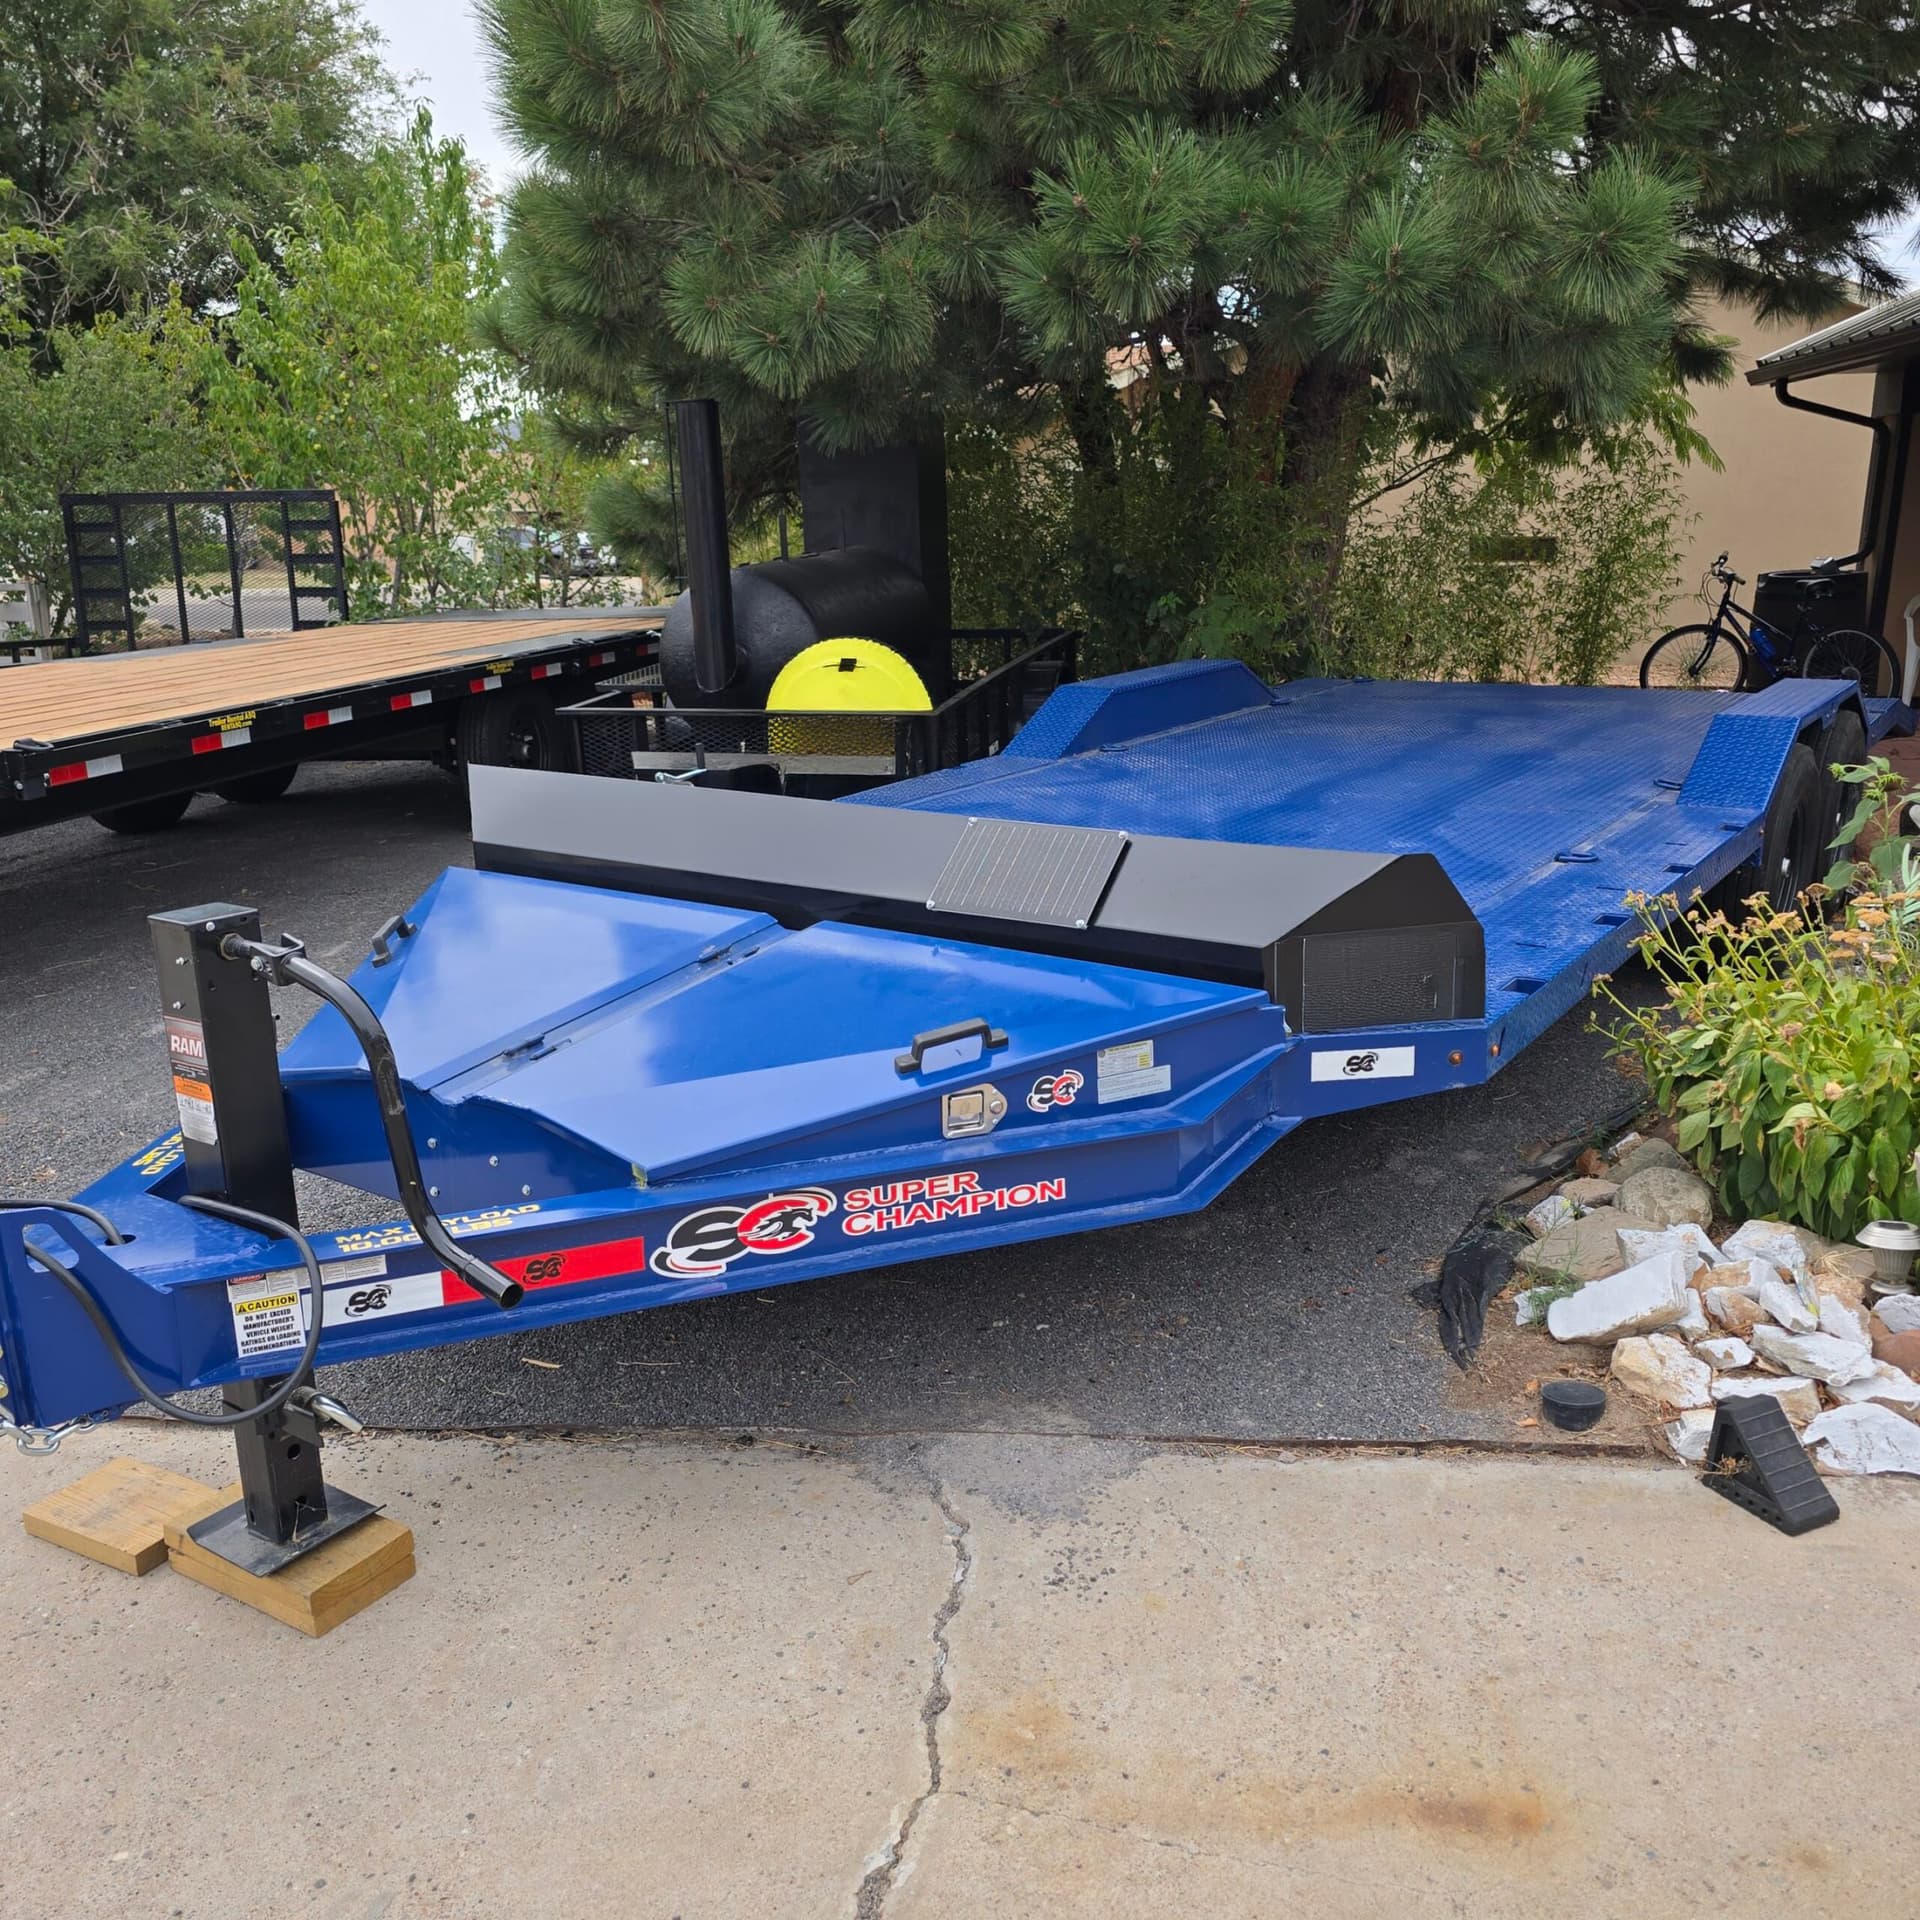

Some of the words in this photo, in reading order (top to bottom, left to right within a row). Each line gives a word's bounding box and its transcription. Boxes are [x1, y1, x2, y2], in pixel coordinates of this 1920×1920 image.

[170, 1034, 203, 1058] RAM
[844, 1170, 979, 1211] SUPER
[842, 1178, 1066, 1236] CHAMPION
[335, 1226, 404, 1243] MAX
[408, 1204, 541, 1231] YLOAD
[451, 1217, 513, 1235] LBS
[247, 1295, 296, 1311] CAUTION
[243, 1315, 295, 1330] MANUFACTURER'S
[256, 1312, 268, 1320] NOT
[270, 1308, 292, 1318] EXCEED
[241, 1337, 266, 1347] RATINGS
[267, 1334, 276, 1342] OR
[276, 1330, 302, 1340] LOADING
[246, 1328, 270, 1338] VEHICLE
[271, 1323, 294, 1334] WEIGHT
